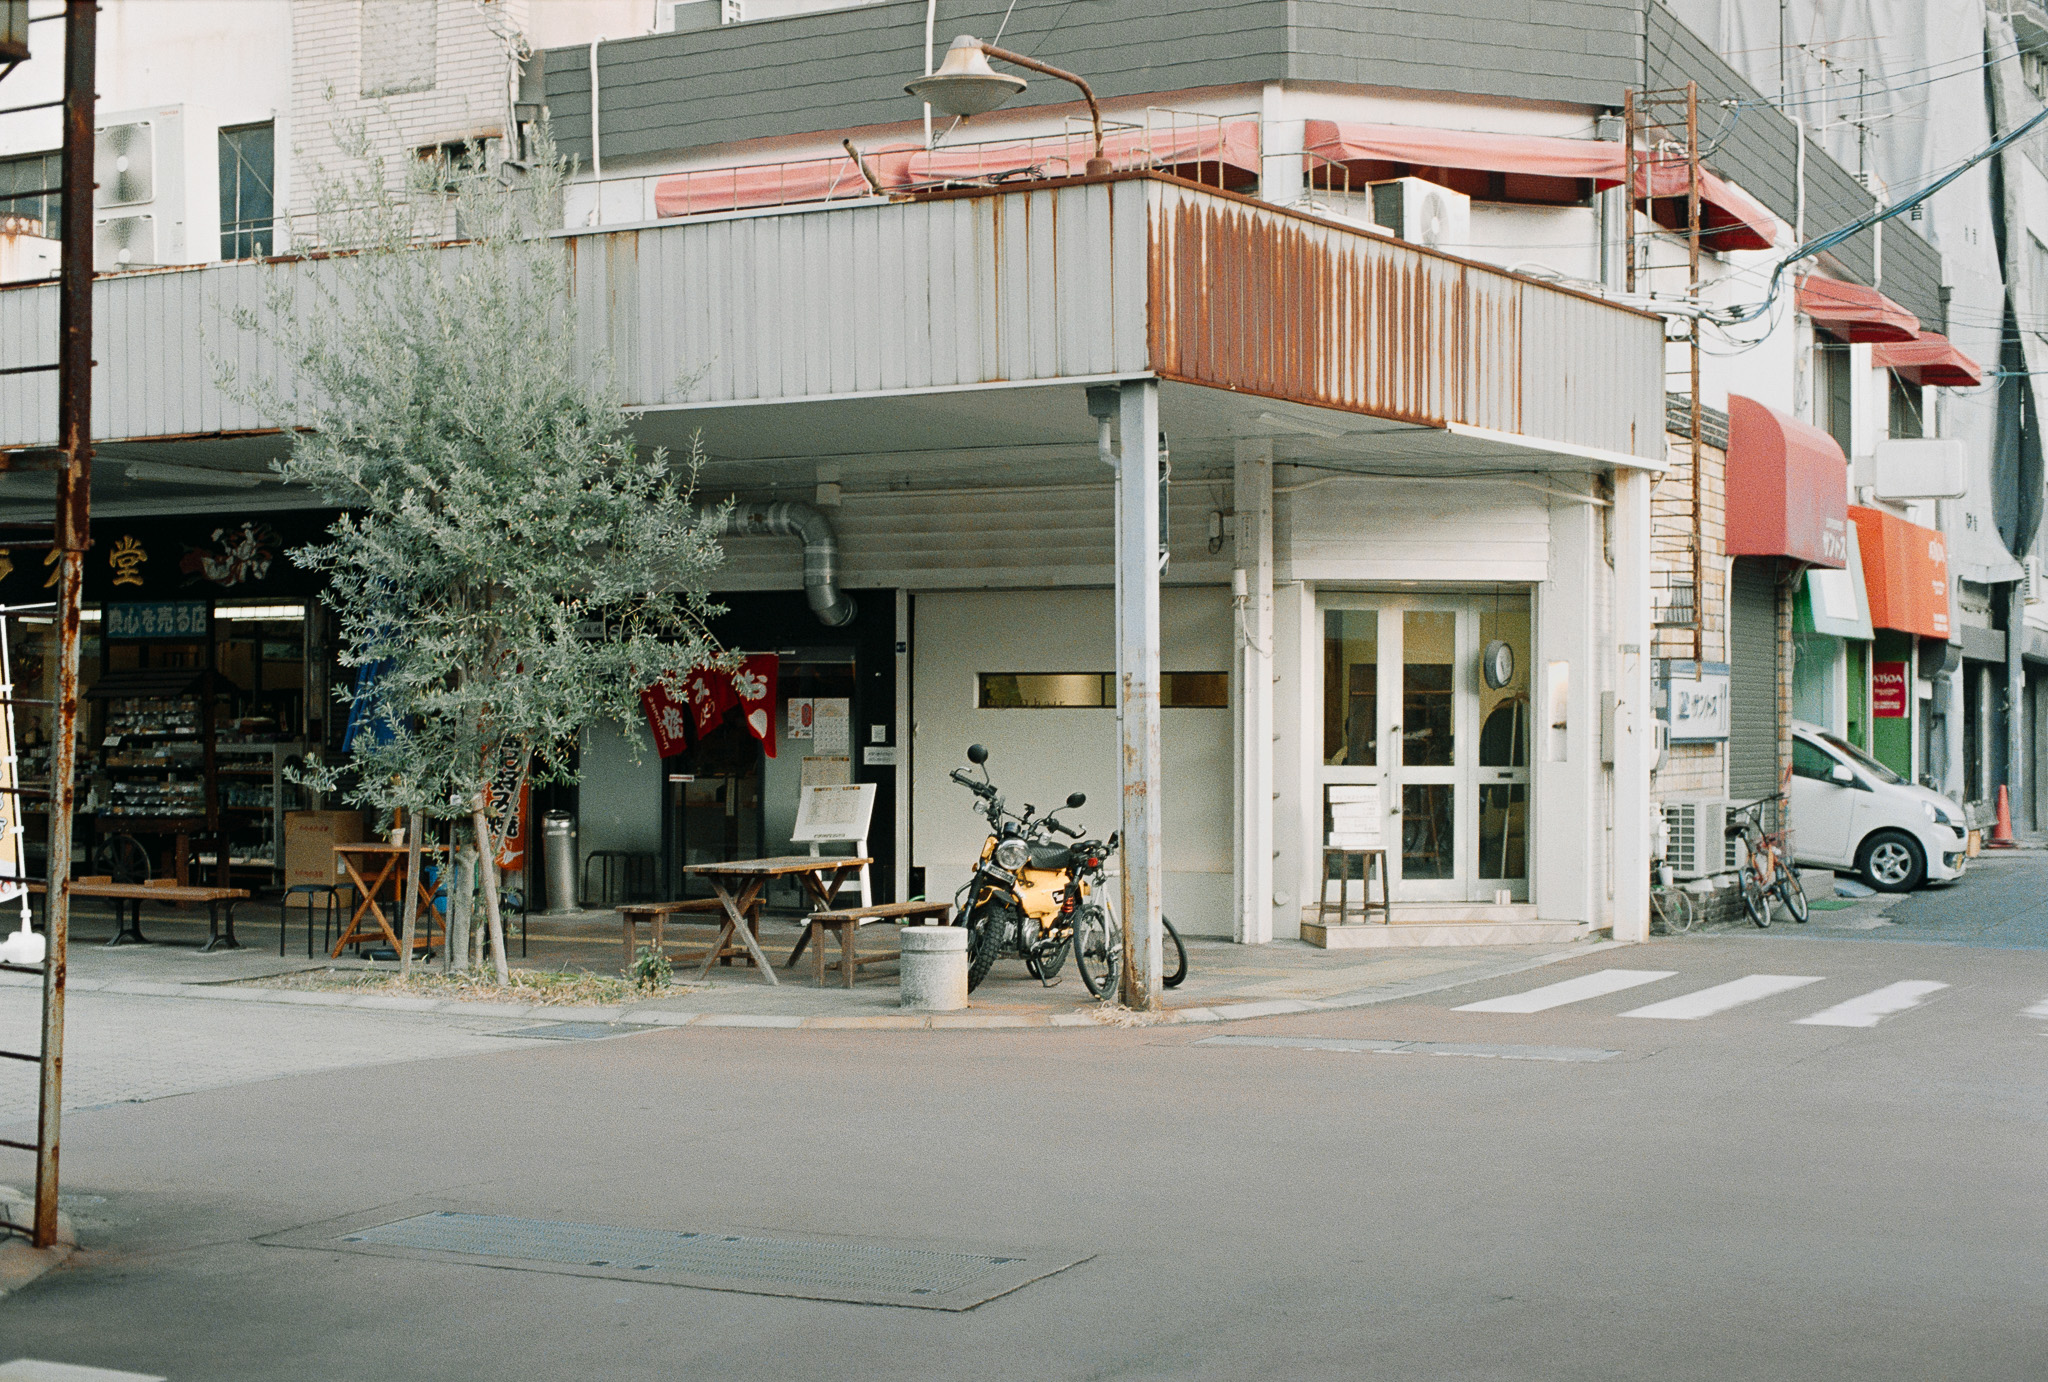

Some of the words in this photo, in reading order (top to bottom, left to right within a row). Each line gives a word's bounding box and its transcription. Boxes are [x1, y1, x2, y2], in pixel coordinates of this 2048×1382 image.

[107, 605, 208, 634] 良心を売る店
